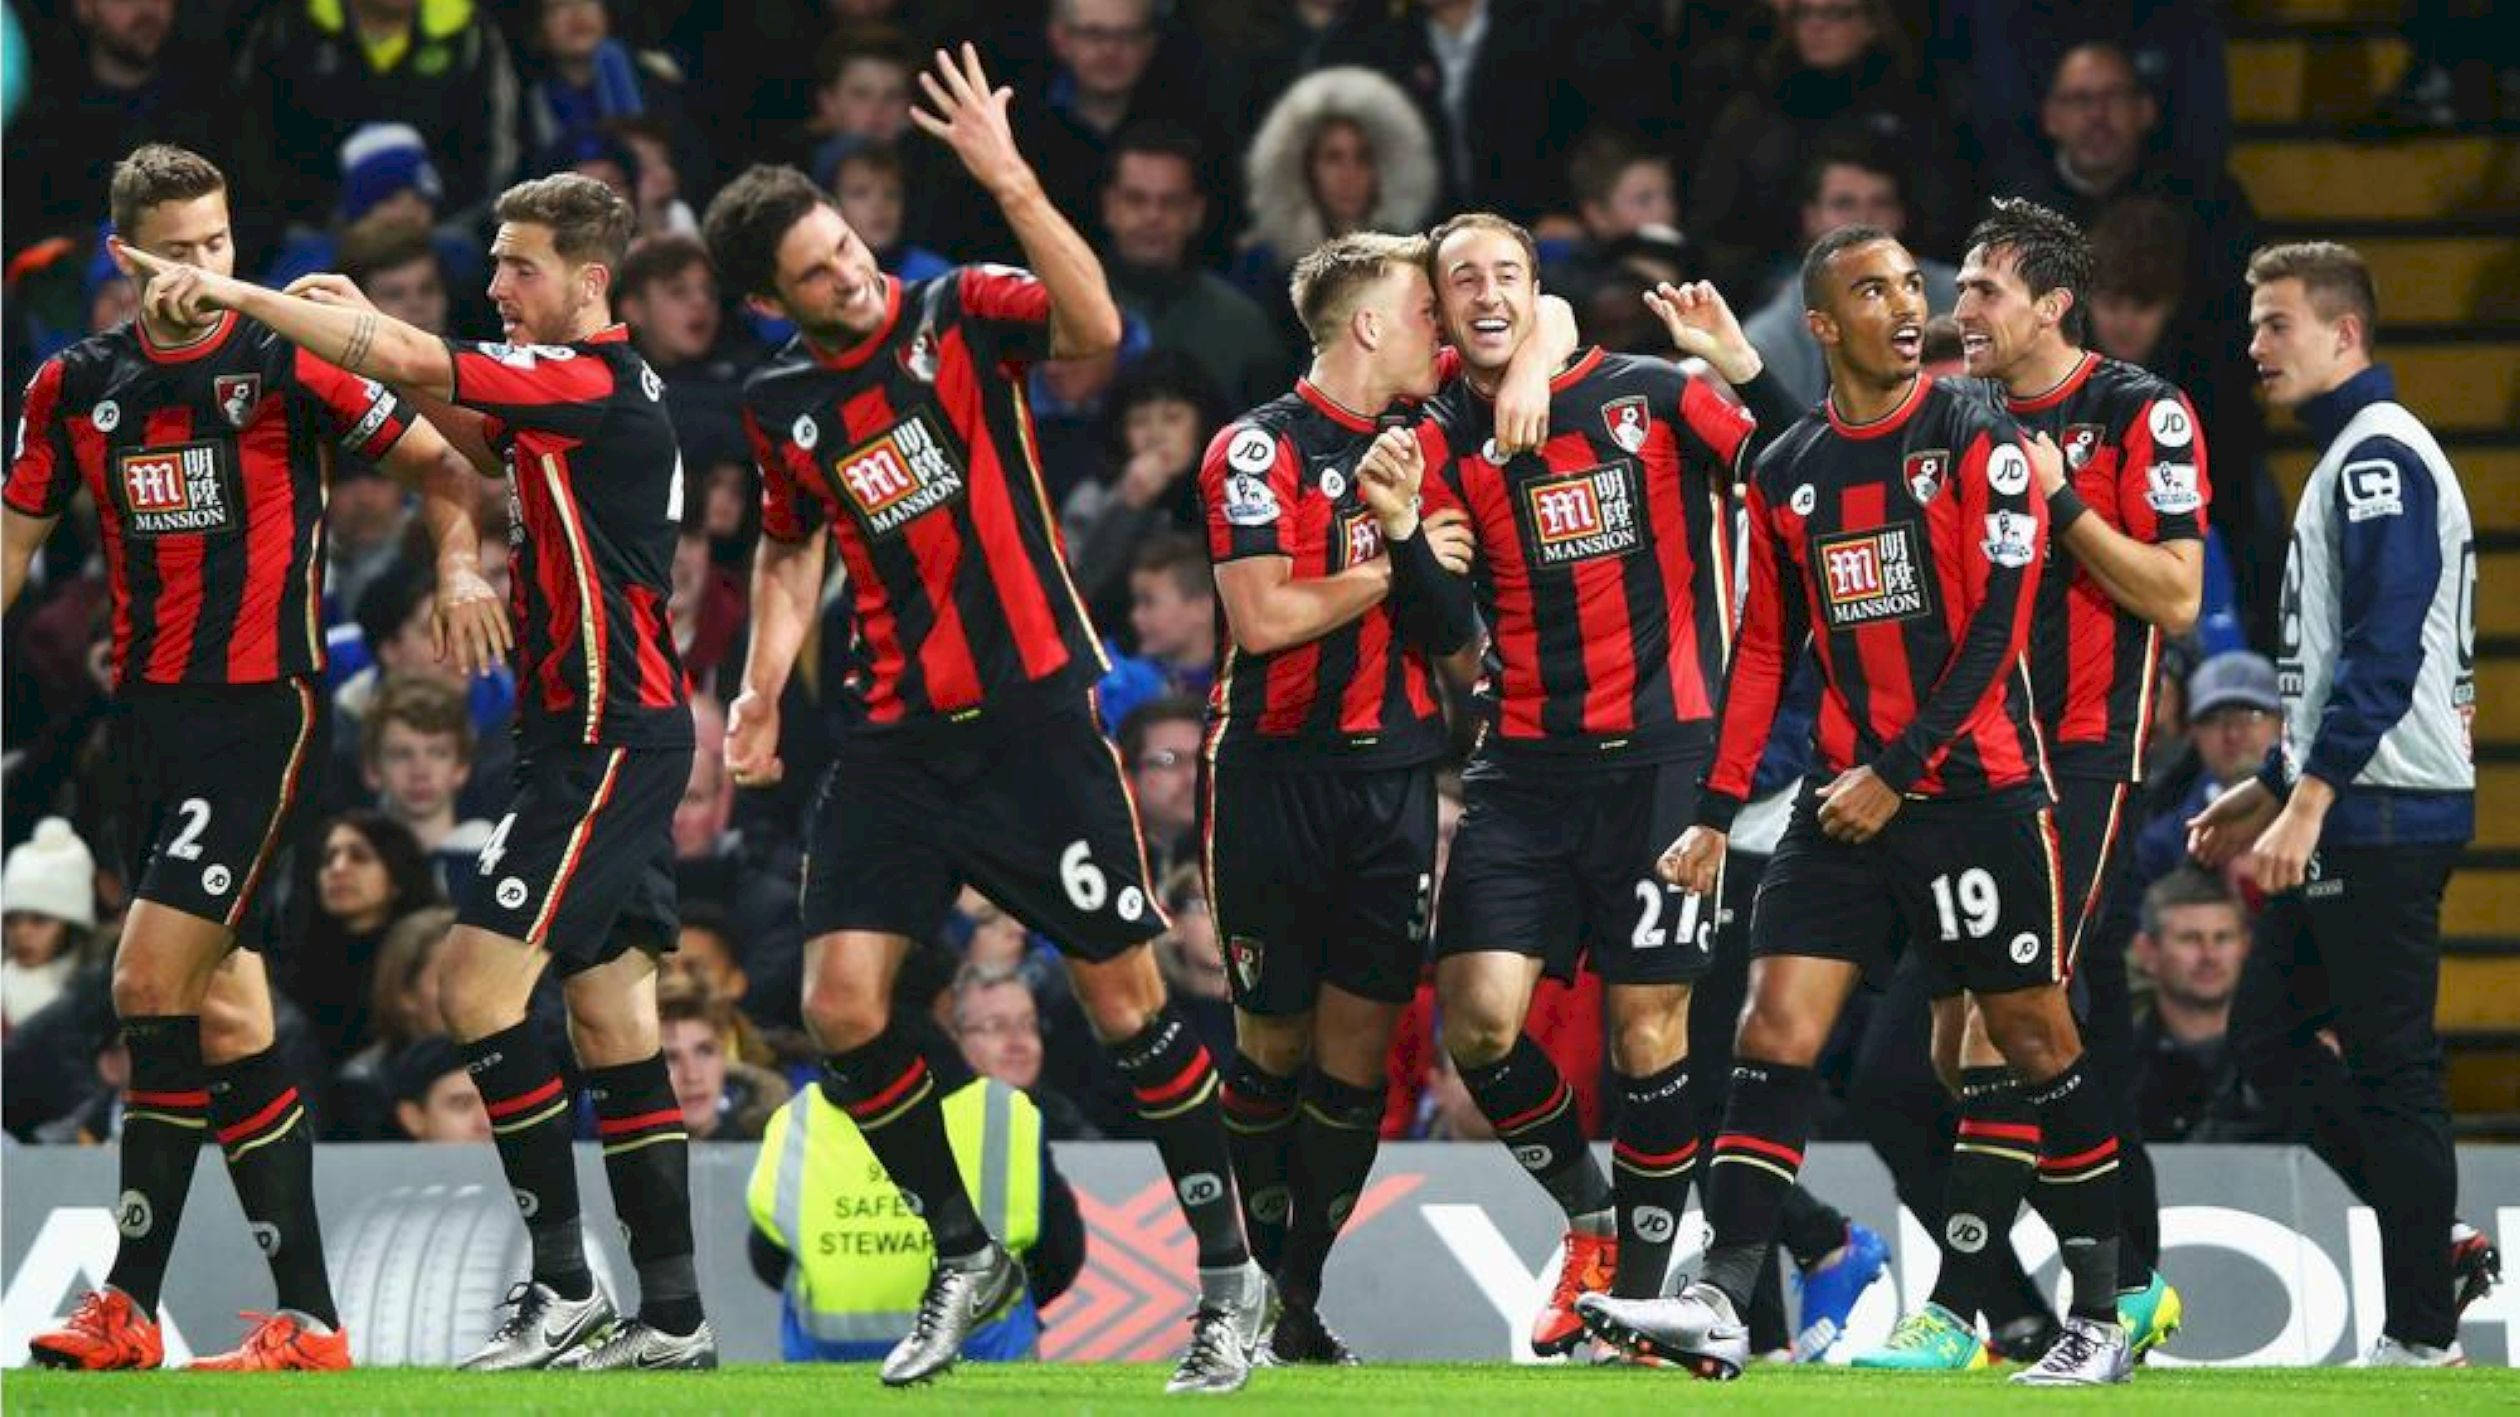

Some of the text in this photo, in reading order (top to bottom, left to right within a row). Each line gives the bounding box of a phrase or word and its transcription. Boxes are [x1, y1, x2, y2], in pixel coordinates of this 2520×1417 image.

[2160, 415, 2185, 434] JD
[1236, 441, 1268, 462] JD
[1997, 458, 2024, 482] JD
[135, 507, 226, 531] MANSION
[869, 471, 962, 534] MANSION
[1543, 529, 1636, 562] MANSION
[1832, 591, 1921, 624] MANSION
[166, 798, 211, 861] 2
[478, 812, 518, 876] 4
[1061, 839, 1107, 912] 6
[1631, 879, 1701, 948] 27
[1930, 867, 2000, 941] 19
[121, 1203, 146, 1227] JD
[1639, 1213, 1668, 1233] JD
[1952, 1223, 1981, 1243] JD
